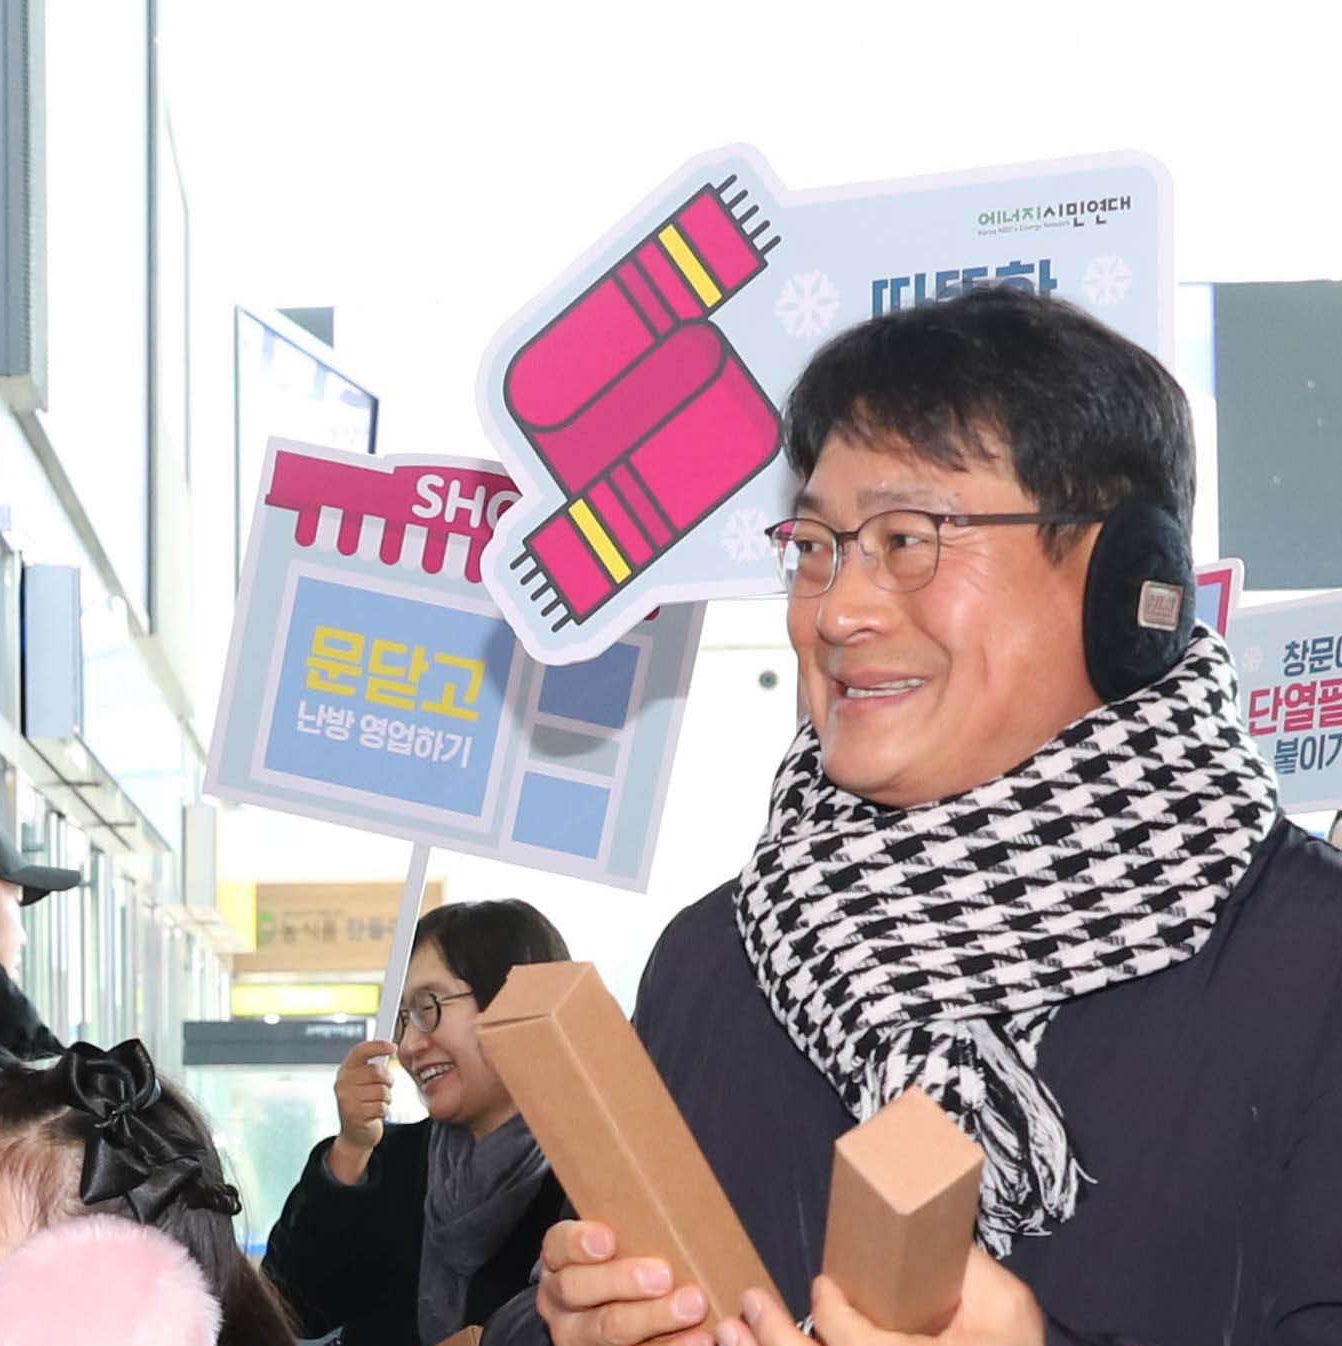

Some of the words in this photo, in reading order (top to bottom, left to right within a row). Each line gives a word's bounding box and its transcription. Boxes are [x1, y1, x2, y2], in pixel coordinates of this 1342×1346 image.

[978, 196, 1131, 228] 에너지시민연대
[412, 474, 523, 530] SHO
[306, 625, 486, 721] 문닫고
[1283, 634, 1342, 677] 창문
[296, 700, 355, 741] 난방
[359, 714, 473, 768] 영업하기
